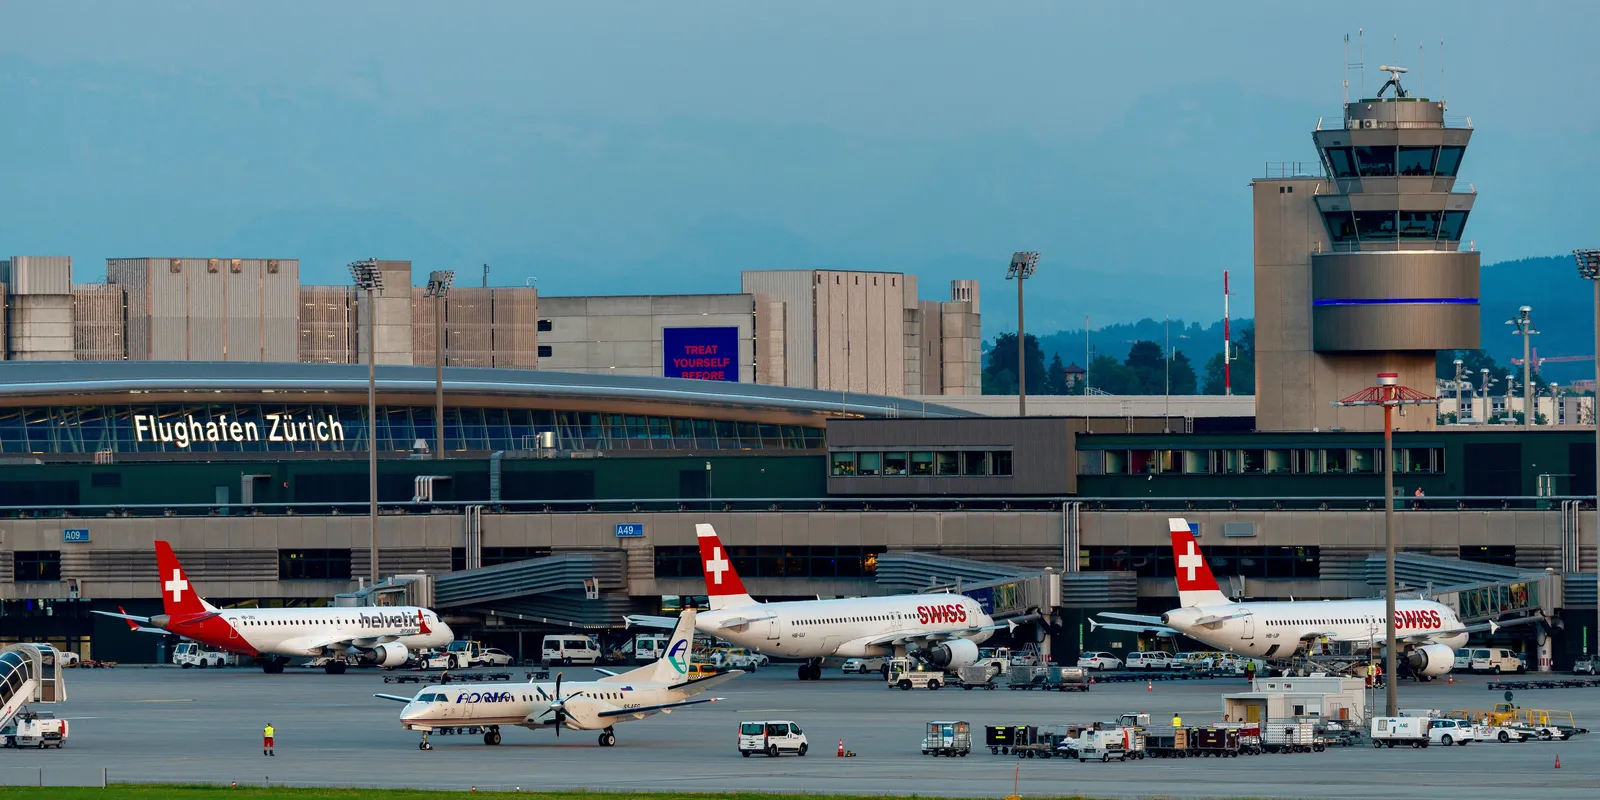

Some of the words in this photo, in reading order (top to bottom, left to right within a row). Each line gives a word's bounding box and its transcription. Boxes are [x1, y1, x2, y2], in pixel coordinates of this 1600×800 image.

[684, 345, 718, 354] TREAT
[673, 358, 730, 368] YOURSELF
[681, 371, 725, 380] BEFORE
[134, 415, 259, 448] Flughafen
[266, 415, 345, 441] Zürich
[65, 530, 81, 540] A09
[617, 525, 634, 535] A49
[917, 604, 967, 625] SWISS
[1394, 609, 1442, 630] SWISS
[456, 691, 514, 704] ADRIA
